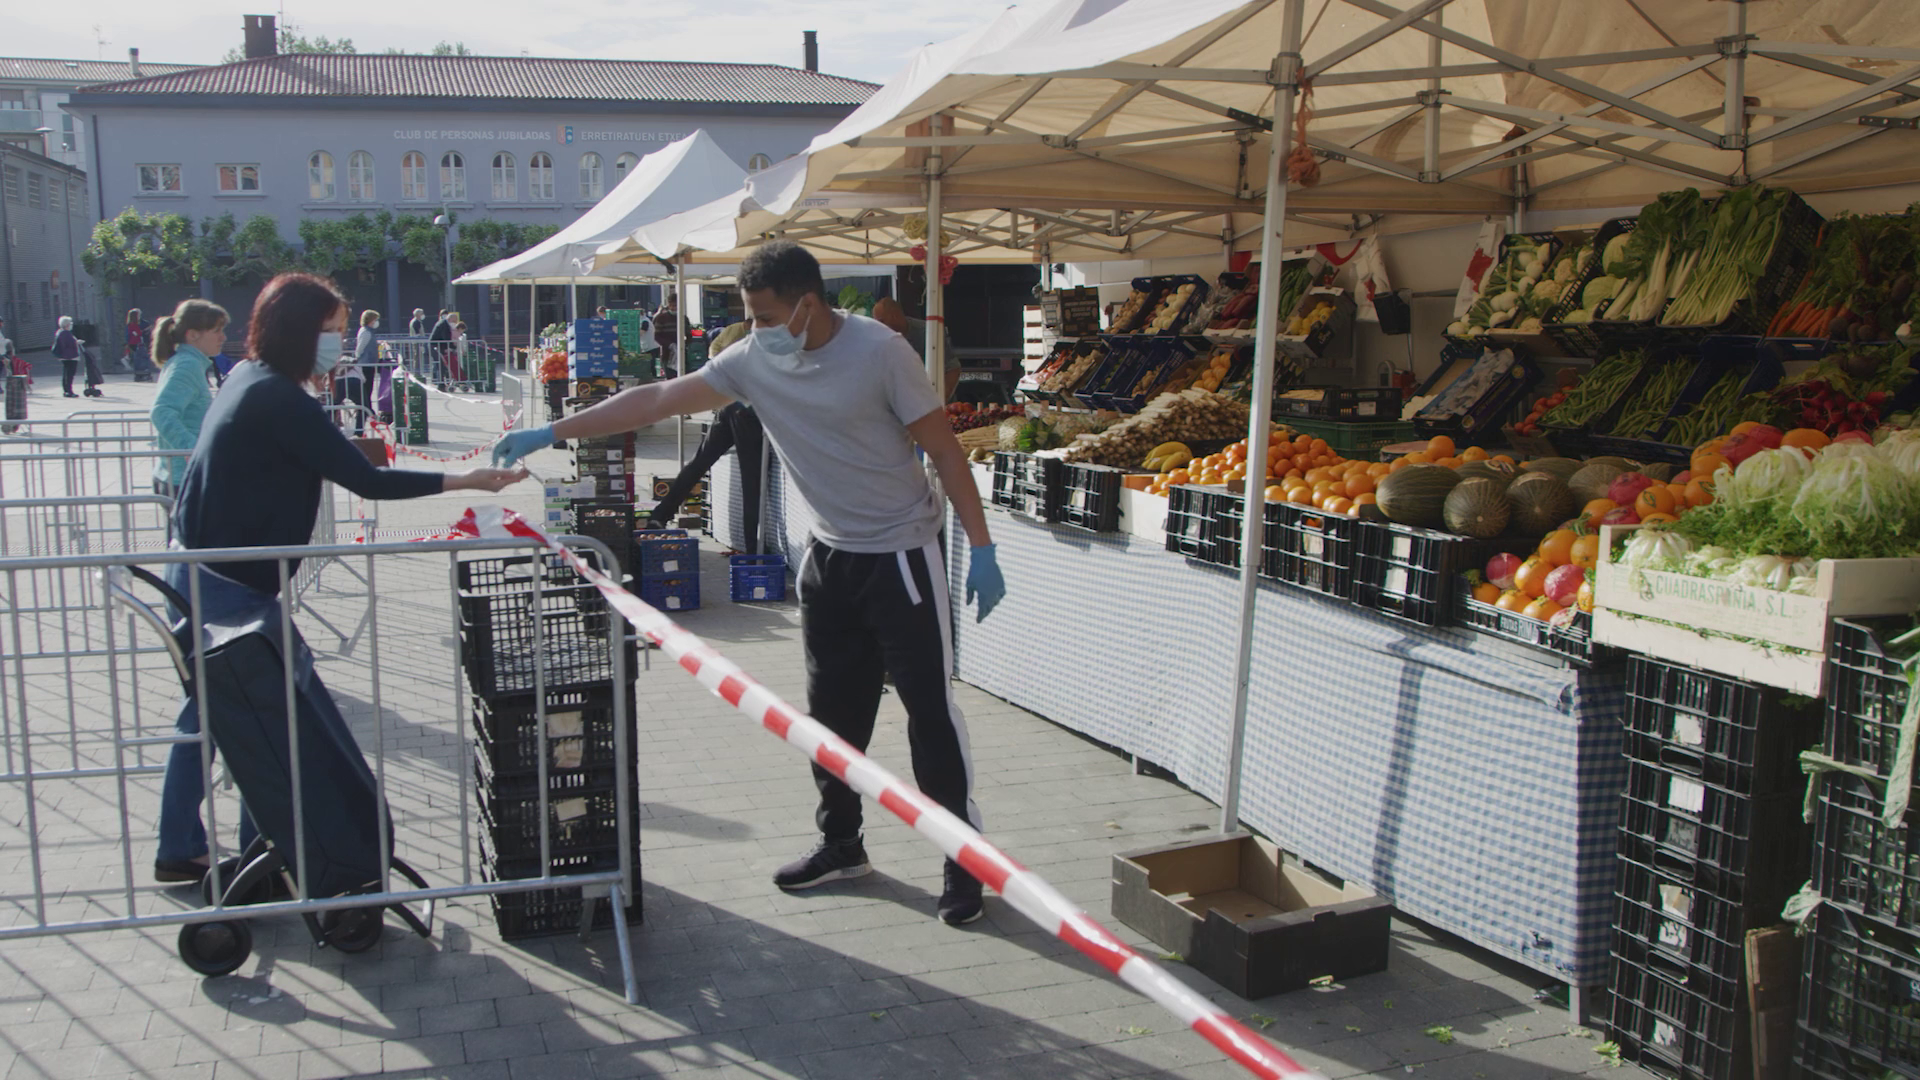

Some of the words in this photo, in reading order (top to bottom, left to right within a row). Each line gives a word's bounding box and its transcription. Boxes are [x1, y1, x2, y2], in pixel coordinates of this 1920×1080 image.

[393, 130, 421, 139] CLUB
[424, 130, 437, 139] DE
[440, 130, 494, 140] PERSONAS
[498, 130, 551, 141] JUBILADAS
[581, 131, 655, 141] ERRETIRATUEN
